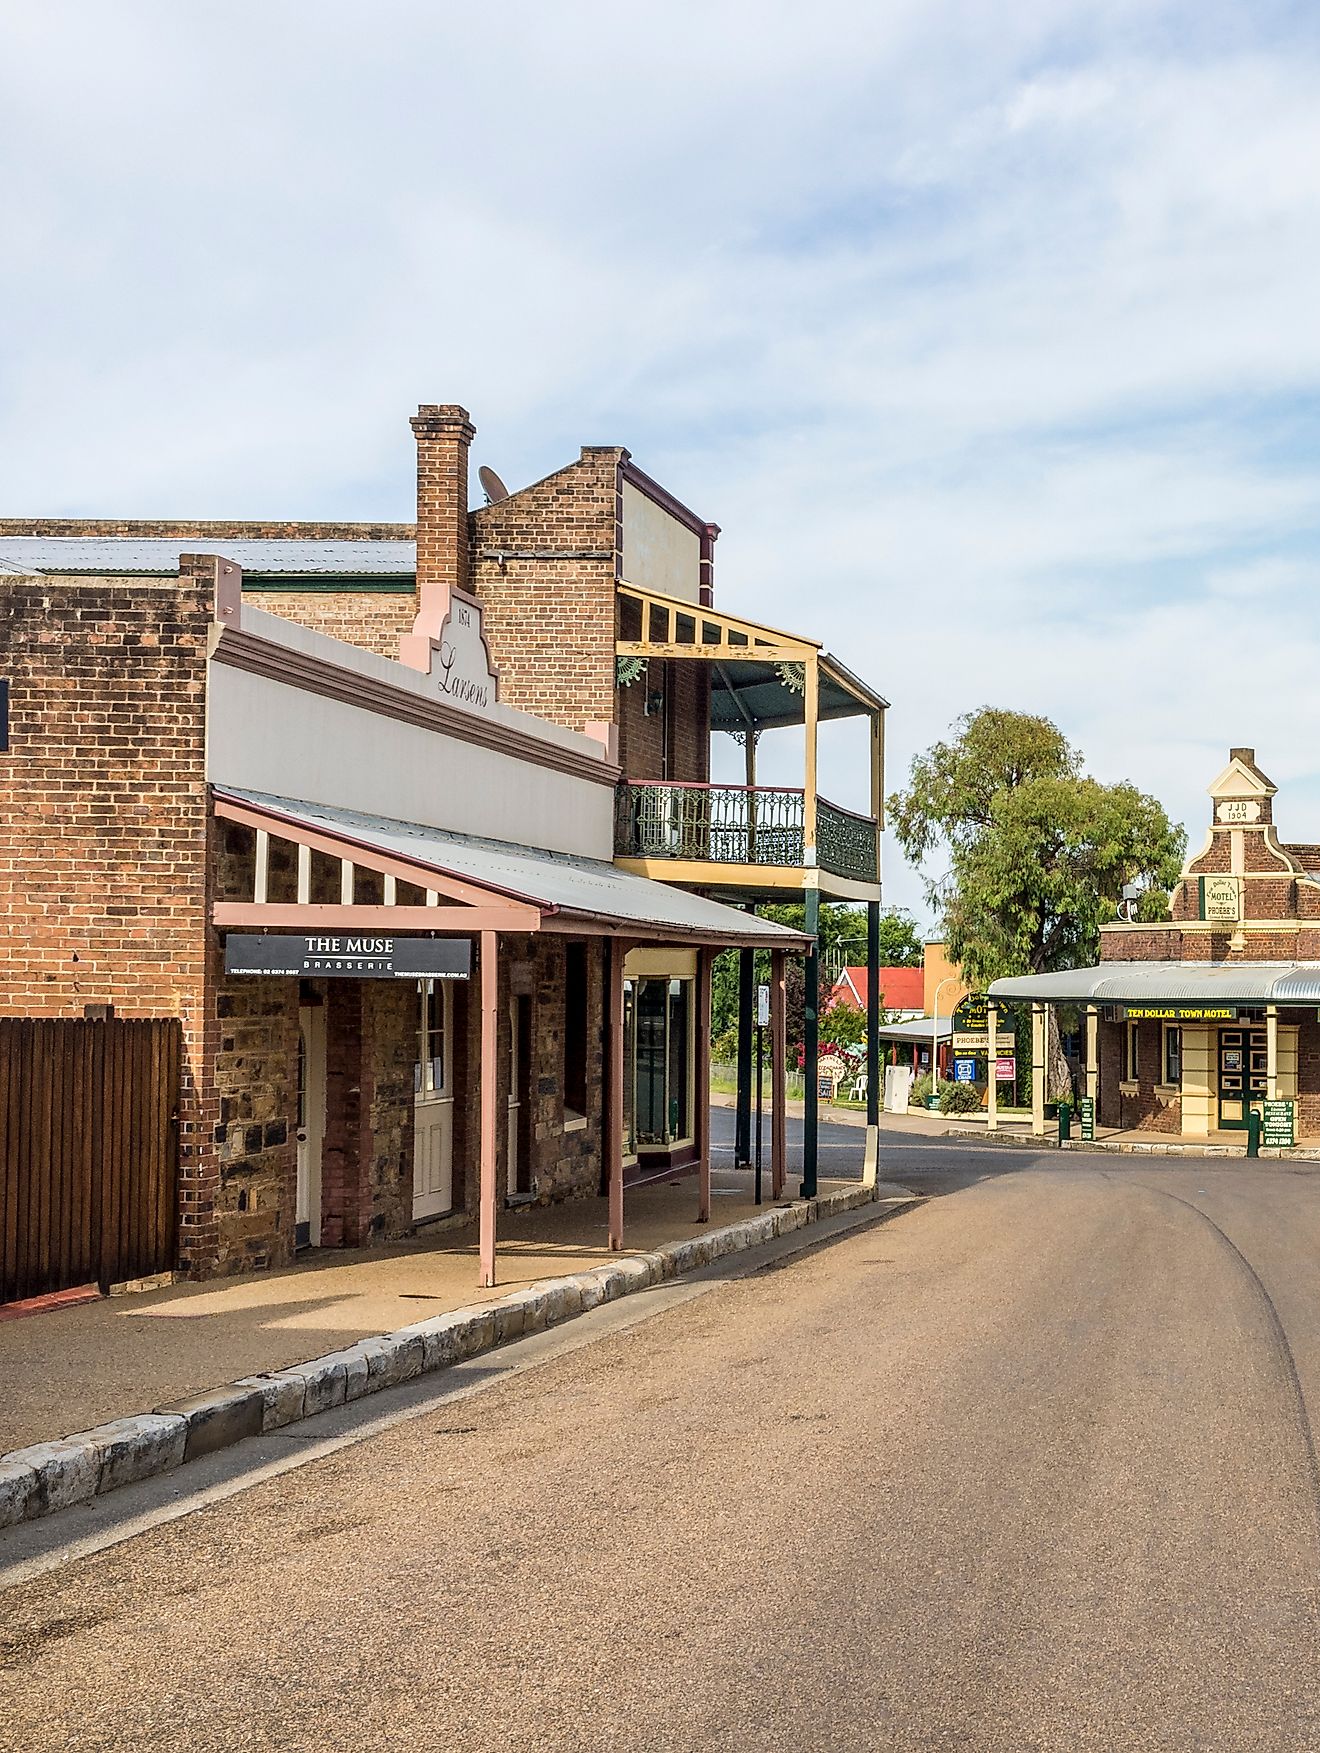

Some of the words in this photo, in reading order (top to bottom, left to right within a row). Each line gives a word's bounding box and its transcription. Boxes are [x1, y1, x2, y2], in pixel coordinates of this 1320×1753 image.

[438, 641, 488, 707] Larsens
[1228, 812, 1247, 820] 1904
[1211, 892, 1234, 901] MOTEL
[1207, 906, 1236, 915] PHOEBE'S
[304, 937, 340, 952] THE
[346, 938, 394, 953] MUSE
[303, 960, 393, 970] BRASSERIE
[1127, 1009, 1143, 1018] TEN
[1144, 1009, 1175, 1018] DOLLAR
[1179, 1009, 1203, 1018] TOWN
[1203, 1009, 1232, 1019] MOTEL
